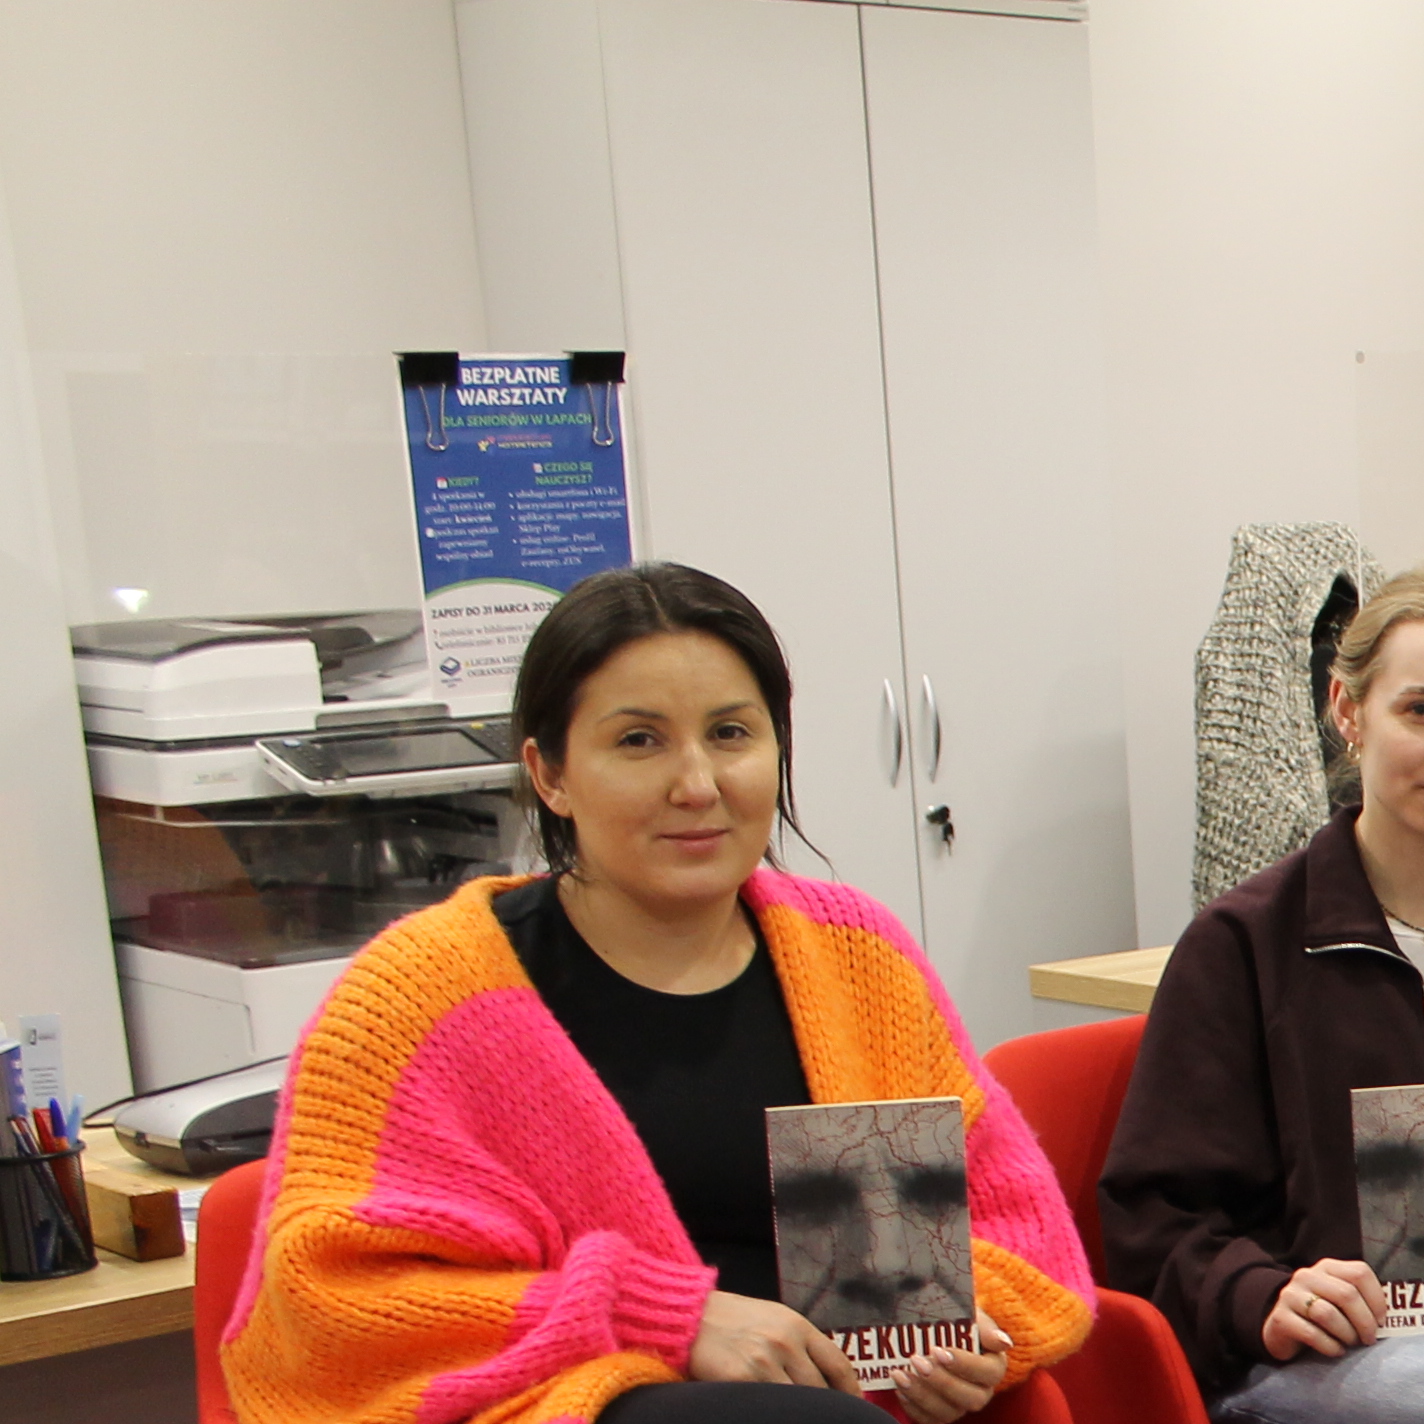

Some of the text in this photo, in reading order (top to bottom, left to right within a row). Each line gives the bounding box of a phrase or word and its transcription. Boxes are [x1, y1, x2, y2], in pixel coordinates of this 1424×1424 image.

[461, 366, 560, 385] BEZPŁATNE
[456, 387, 568, 406] WARSZTATY
[443, 415, 464, 428] DLA
[466, 412, 530, 427] SENIORÓW
[531, 414, 543, 425] W
[466, 606, 480, 616] DO
[494, 602, 530, 615] MARCA
[533, 601, 557, 612] 202
[1379, 1315, 1416, 1328] TEFAN
[828, 1318, 973, 1361] ZEKUTOR
[855, 1364, 912, 1382] DĄMB
